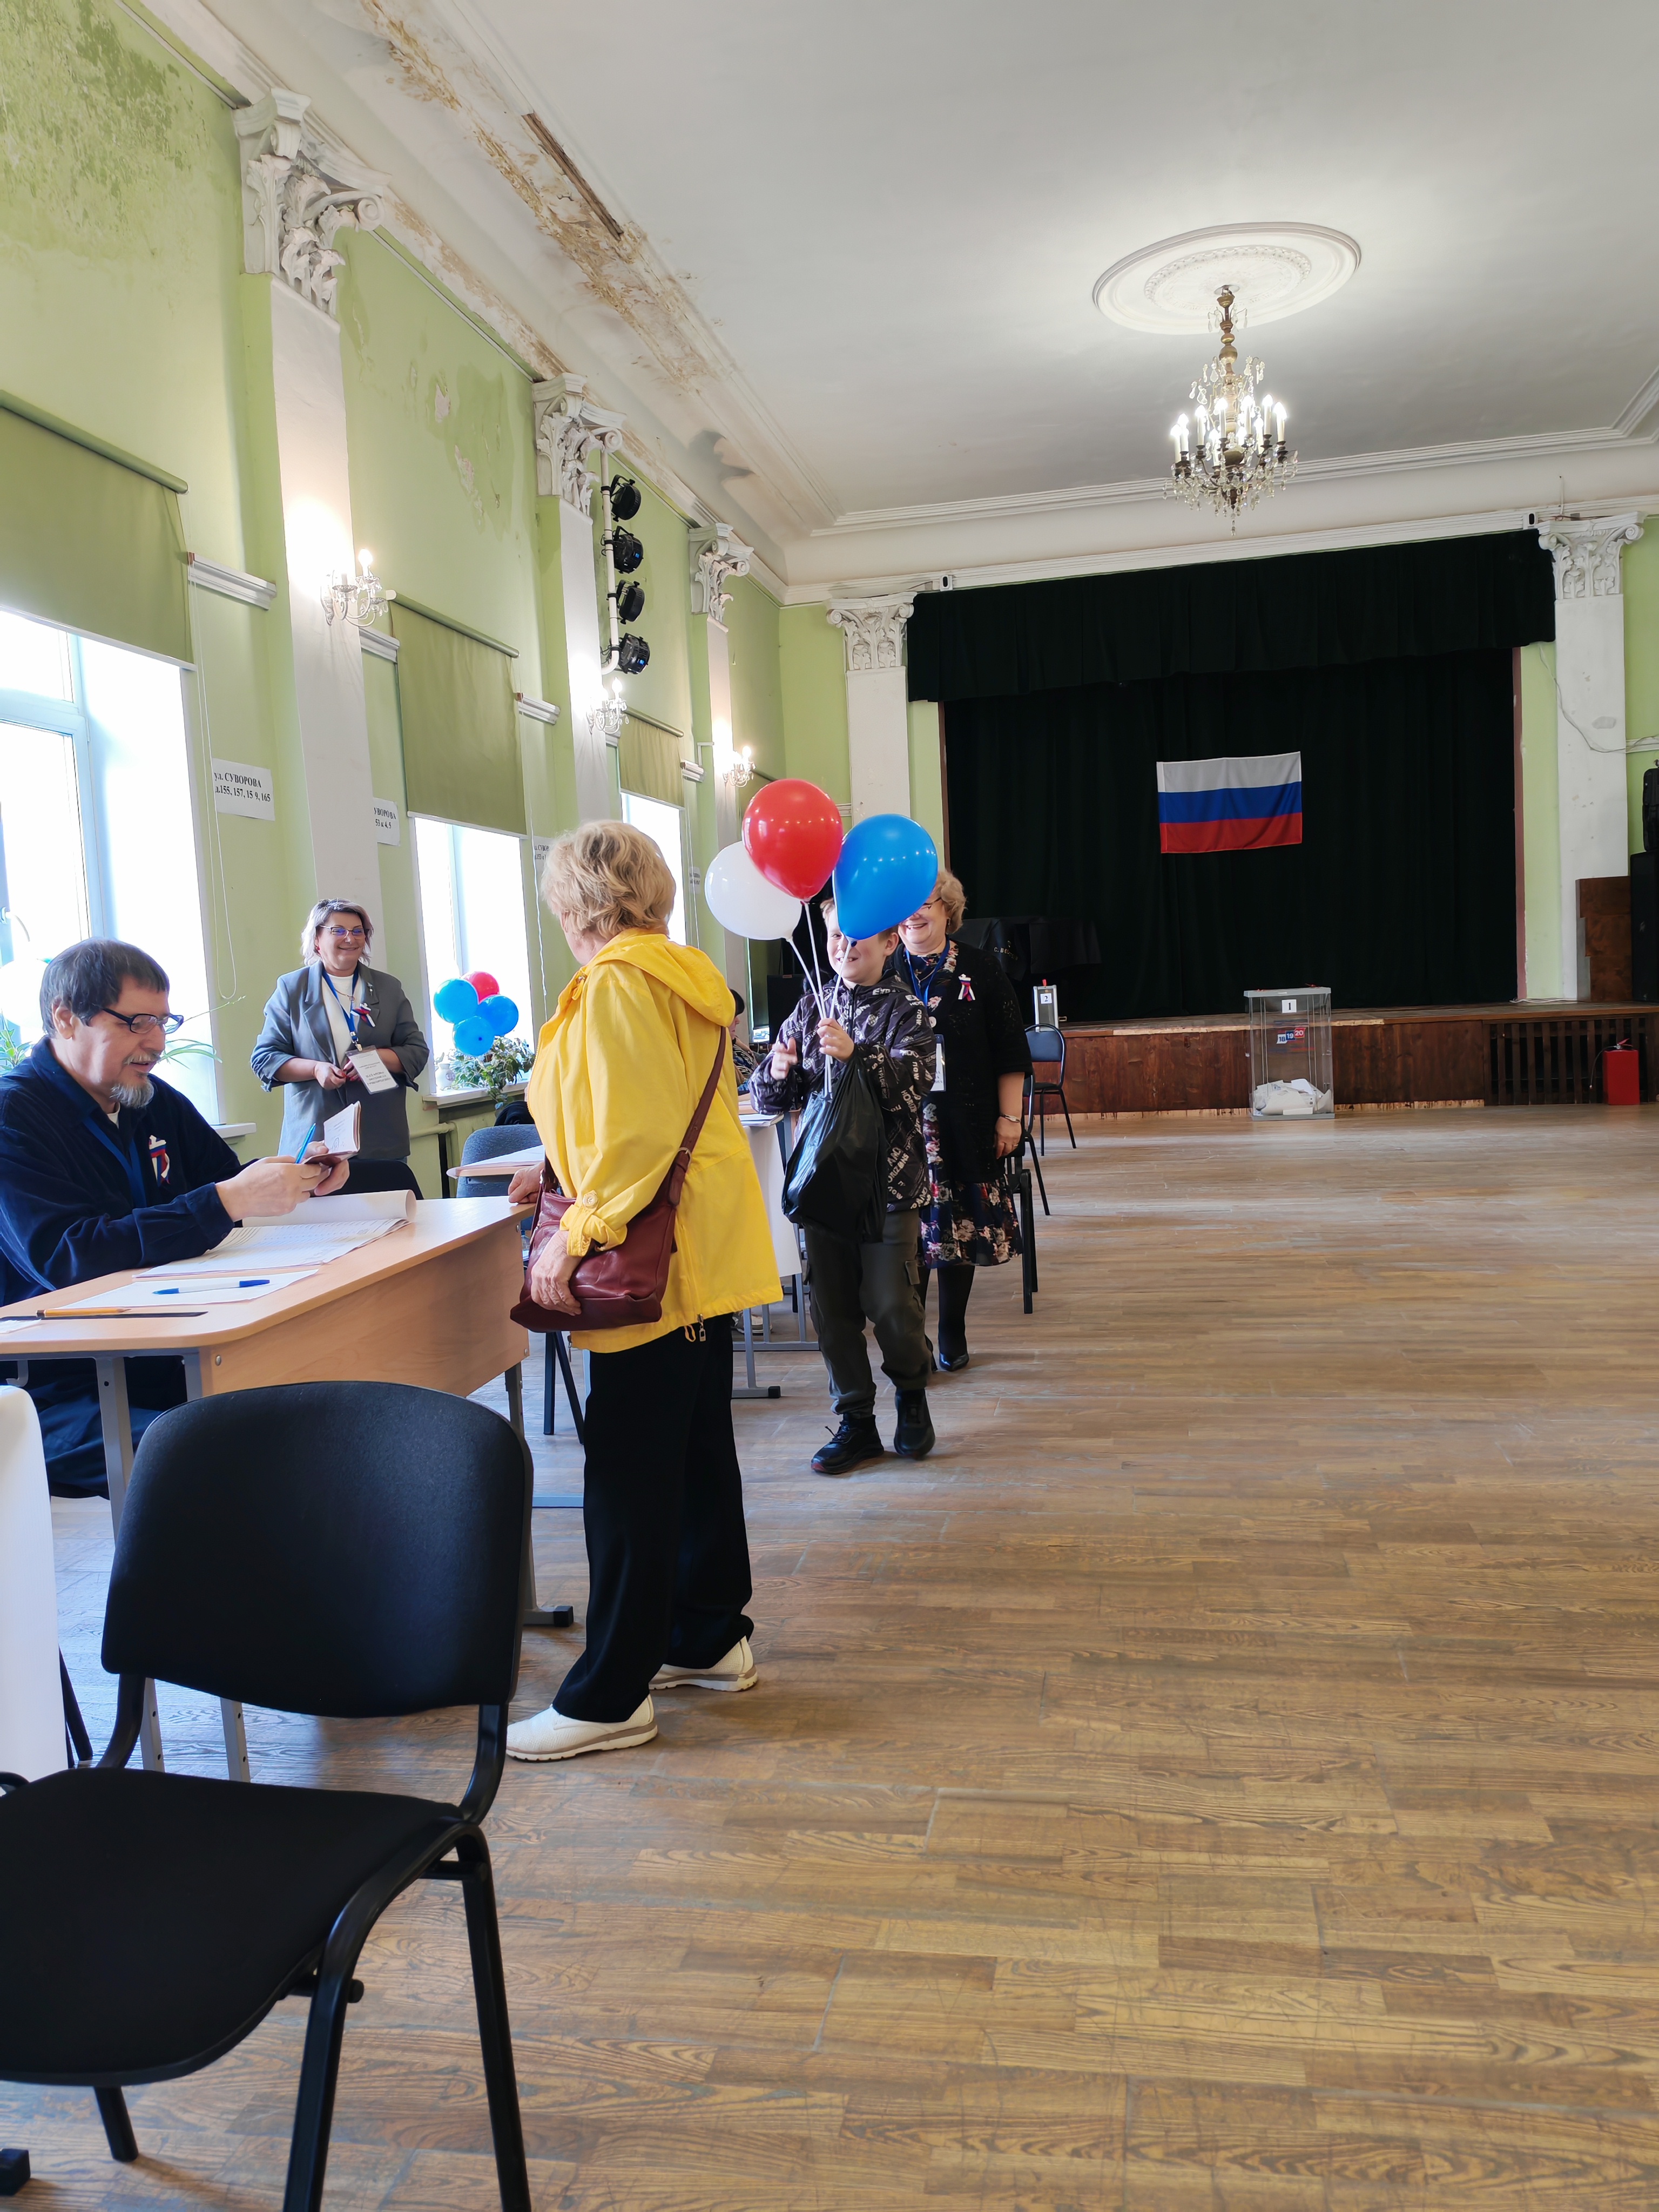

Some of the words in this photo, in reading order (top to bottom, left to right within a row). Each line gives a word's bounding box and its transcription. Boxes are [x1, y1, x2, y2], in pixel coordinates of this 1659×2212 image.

[214, 772, 223, 781] ул.
[225, 772, 261, 788] СУВОРОВА
[234, 788, 245, 799] 157,
[261, 793, 271, 802] 165
[374, 807, 396, 819] УВОРОВА
